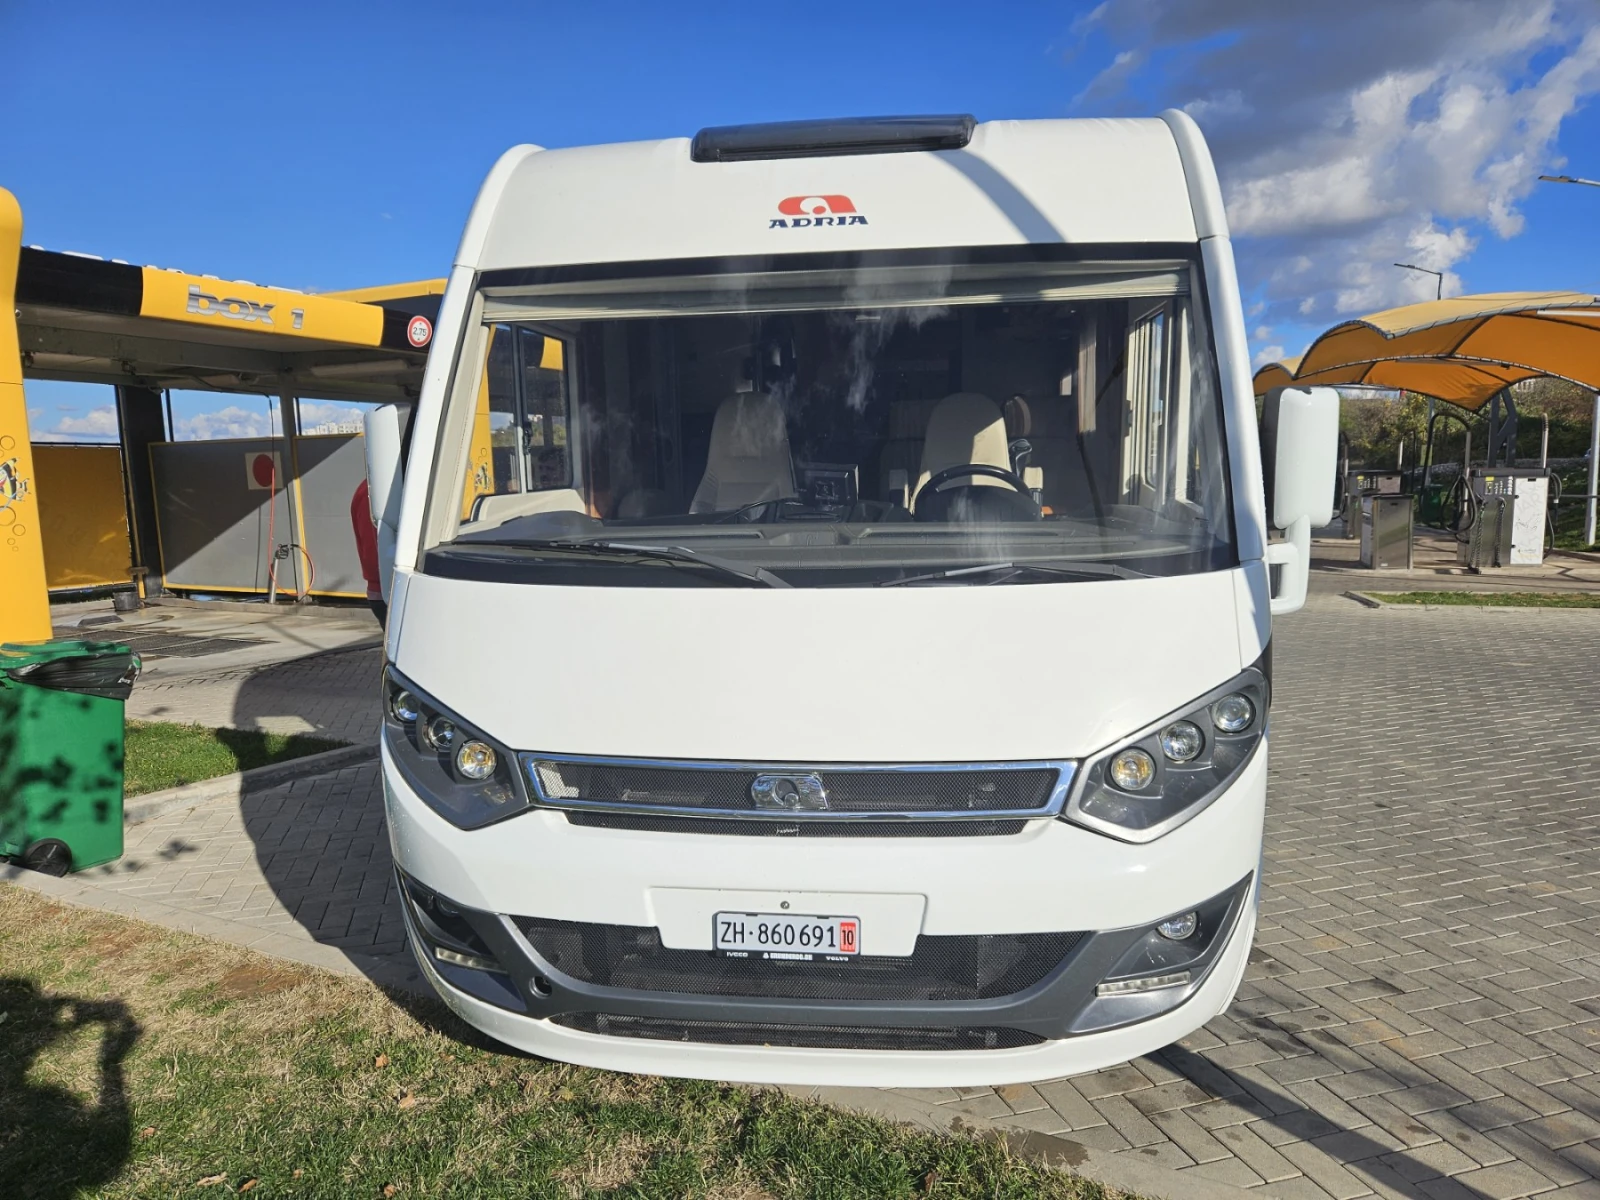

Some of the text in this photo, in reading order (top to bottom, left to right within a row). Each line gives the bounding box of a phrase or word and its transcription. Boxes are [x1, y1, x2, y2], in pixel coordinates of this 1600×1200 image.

[769, 215, 868, 229] ADRIA
[186, 284, 304, 329] box 1
[412, 326, 427, 337] 2.75
[841, 929, 855, 946] 10
